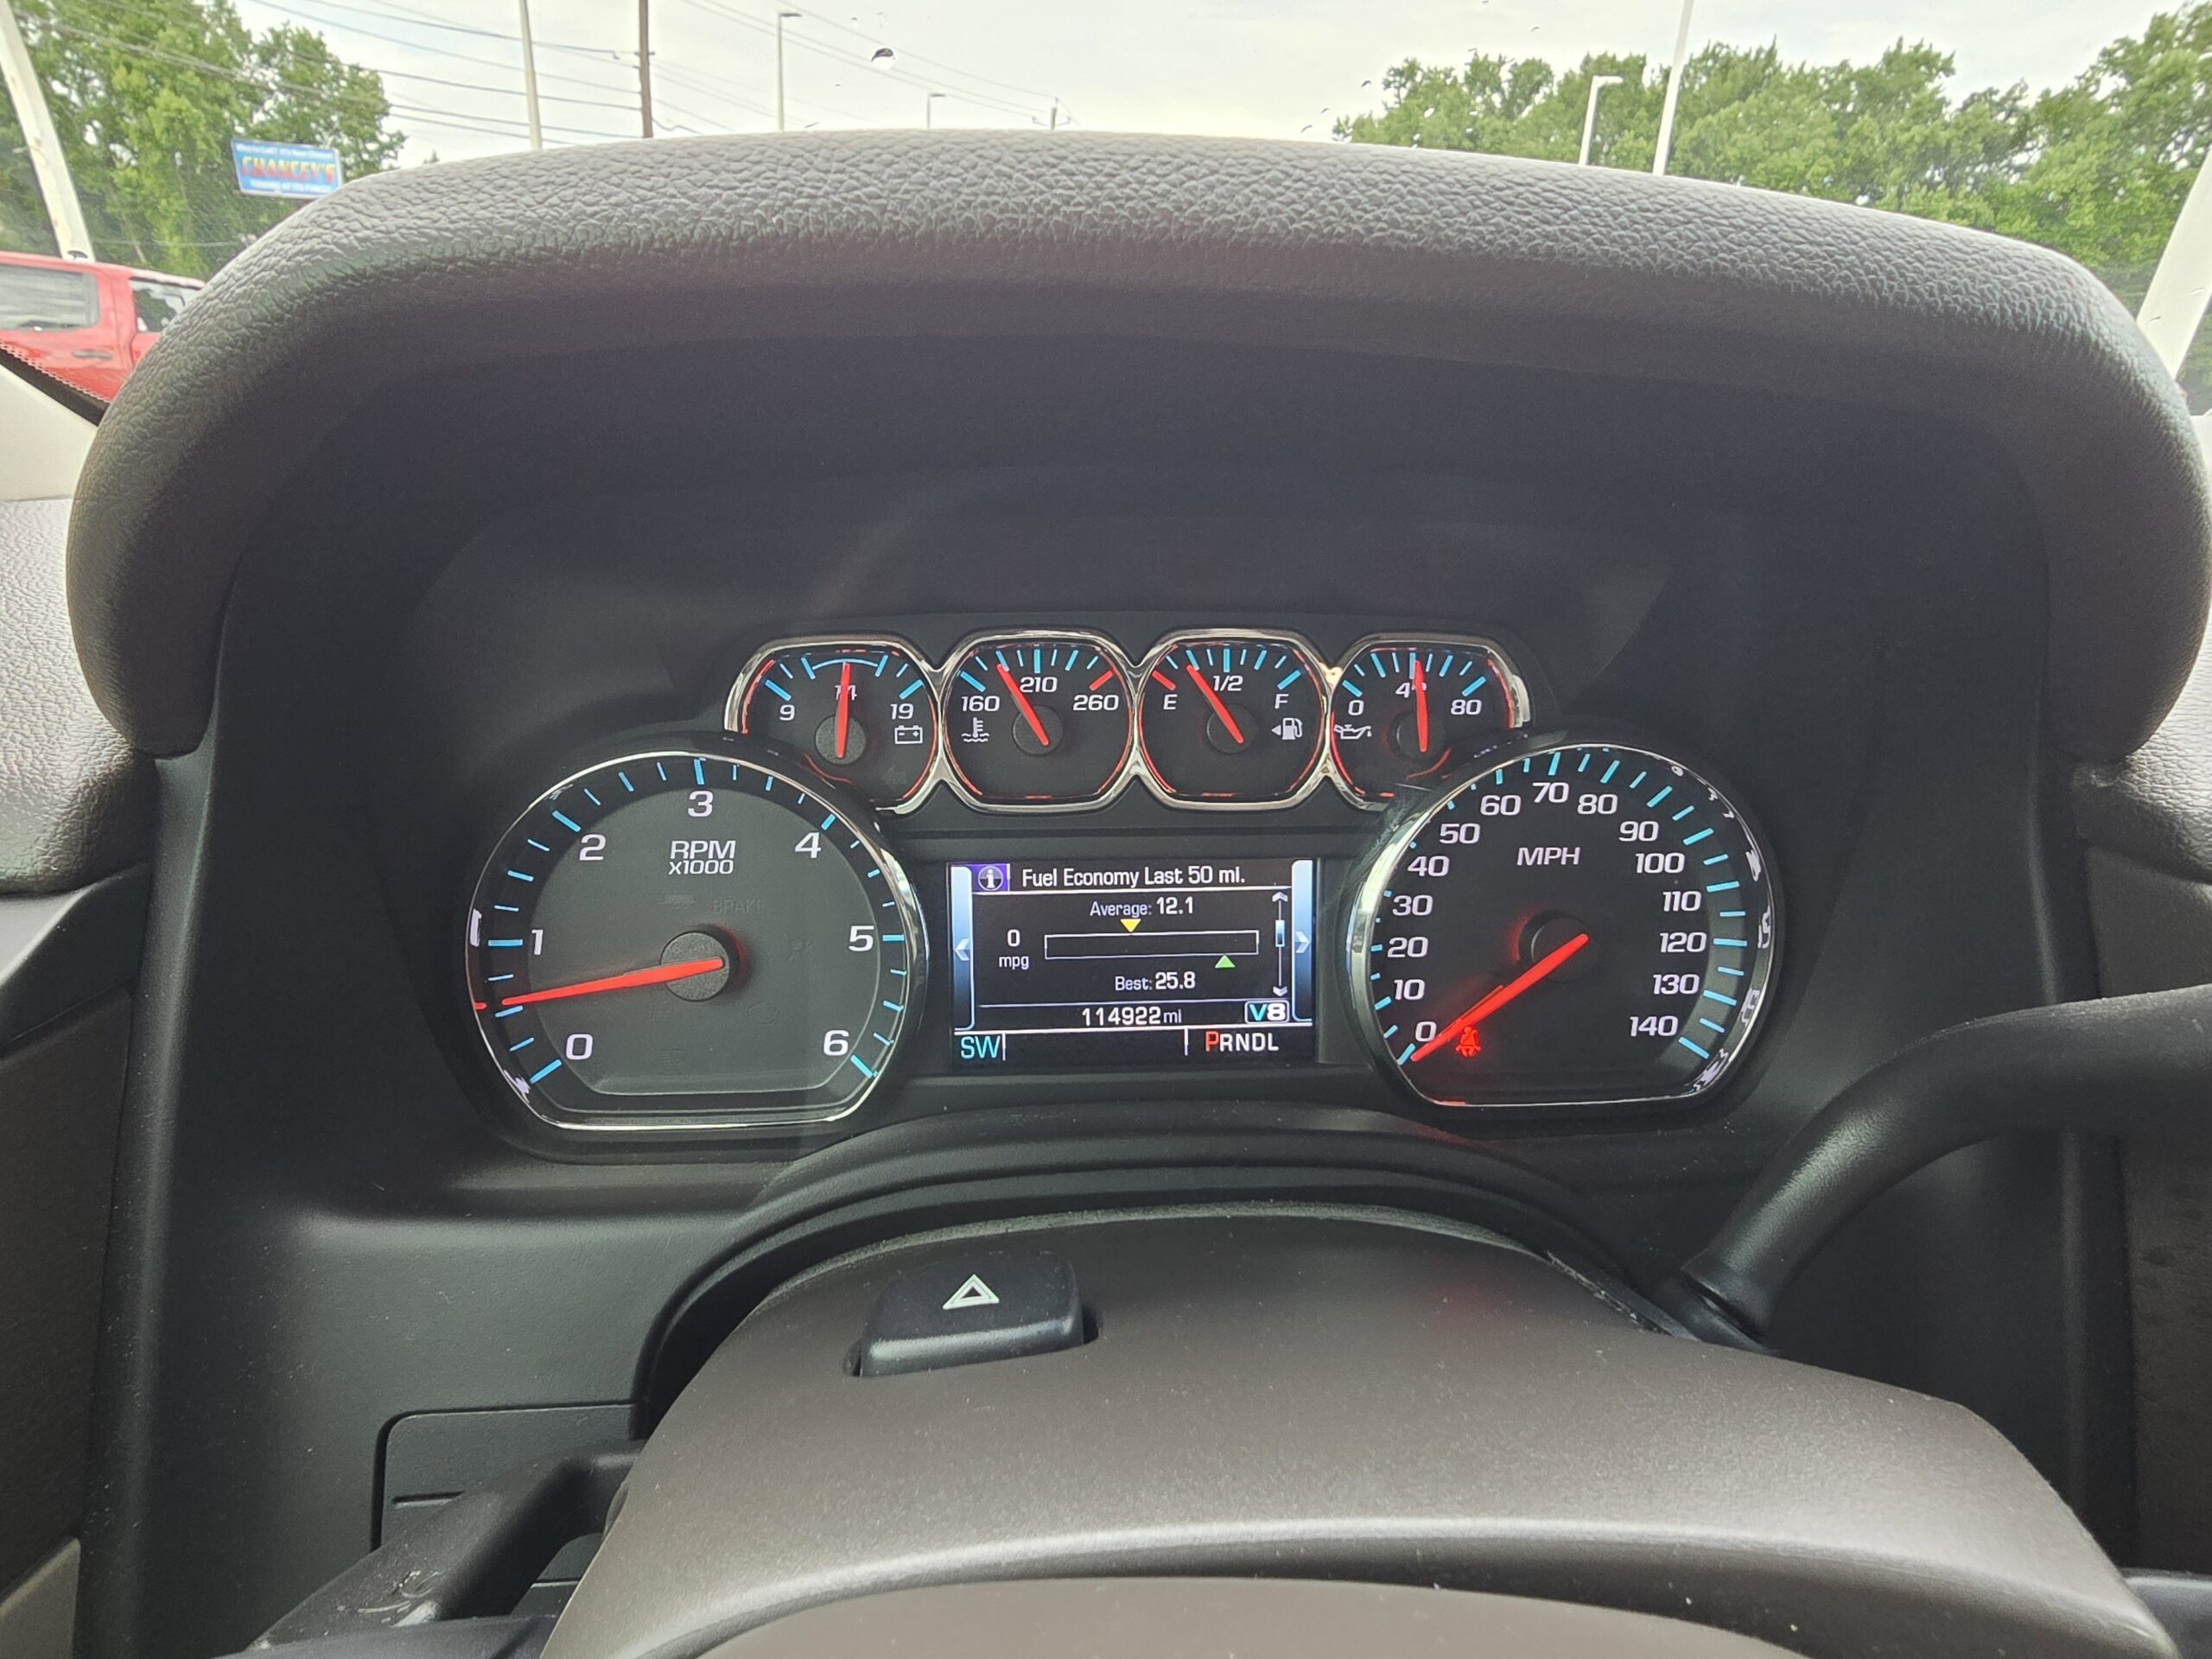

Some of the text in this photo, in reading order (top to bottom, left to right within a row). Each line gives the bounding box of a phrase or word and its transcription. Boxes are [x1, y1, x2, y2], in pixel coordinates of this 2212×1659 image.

[1020, 677, 1058, 692] 210
[1213, 676, 1243, 692] 1/2
[891, 704, 913, 719] 19
[962, 696, 1000, 711] 160
[1073, 696, 1119, 711] 260
[1164, 695, 1177, 709] E
[1275, 694, 1288, 709] F
[1348, 701, 1363, 715] 0
[1451, 700, 1482, 715] 80
[779, 705, 795, 721] 9
[1533, 783, 1569, 803] 70
[688, 791, 713, 817] 3
[1481, 795, 1521, 815] 60
[1578, 794, 1618, 814] 80
[1440, 823, 1480, 843] 50
[1619, 822, 1658, 841] 90
[579, 835, 606, 861] 2
[671, 841, 735, 859] RPM
[795, 832, 821, 858] 4
[1408, 856, 1450, 876] 40
[1517, 848, 1580, 865] MPH
[1636, 853, 1685, 873] 100
[1023, 866, 1244, 889] Fuel Economy Last 50 mi.
[713, 898, 766, 914] BRAKE
[1090, 897, 1192, 918] Average: 12.1
[1393, 895, 1433, 915] 30
[1663, 891, 1701, 912] 110
[532, 930, 543, 955] 1
[849, 925, 874, 951] 5
[1007, 930, 1020, 946] 0
[1388, 937, 1428, 957] 20
[1660, 932, 1707, 952] 120
[999, 957, 1029, 969] mpg
[1116, 971, 1195, 990] Best: 25.8
[1394, 980, 1425, 1001] 10
[1653, 975, 1699, 995] 130
[1249, 1002, 1286, 1021] V8
[1415, 1021, 1437, 1042] 0
[1630, 1016, 1678, 1037] 140
[566, 1034, 593, 1061] 0
[823, 1030, 849, 1056] 6
[961, 1037, 1001, 1059] SW
[1205, 1032, 1279, 1052] PRNDL
